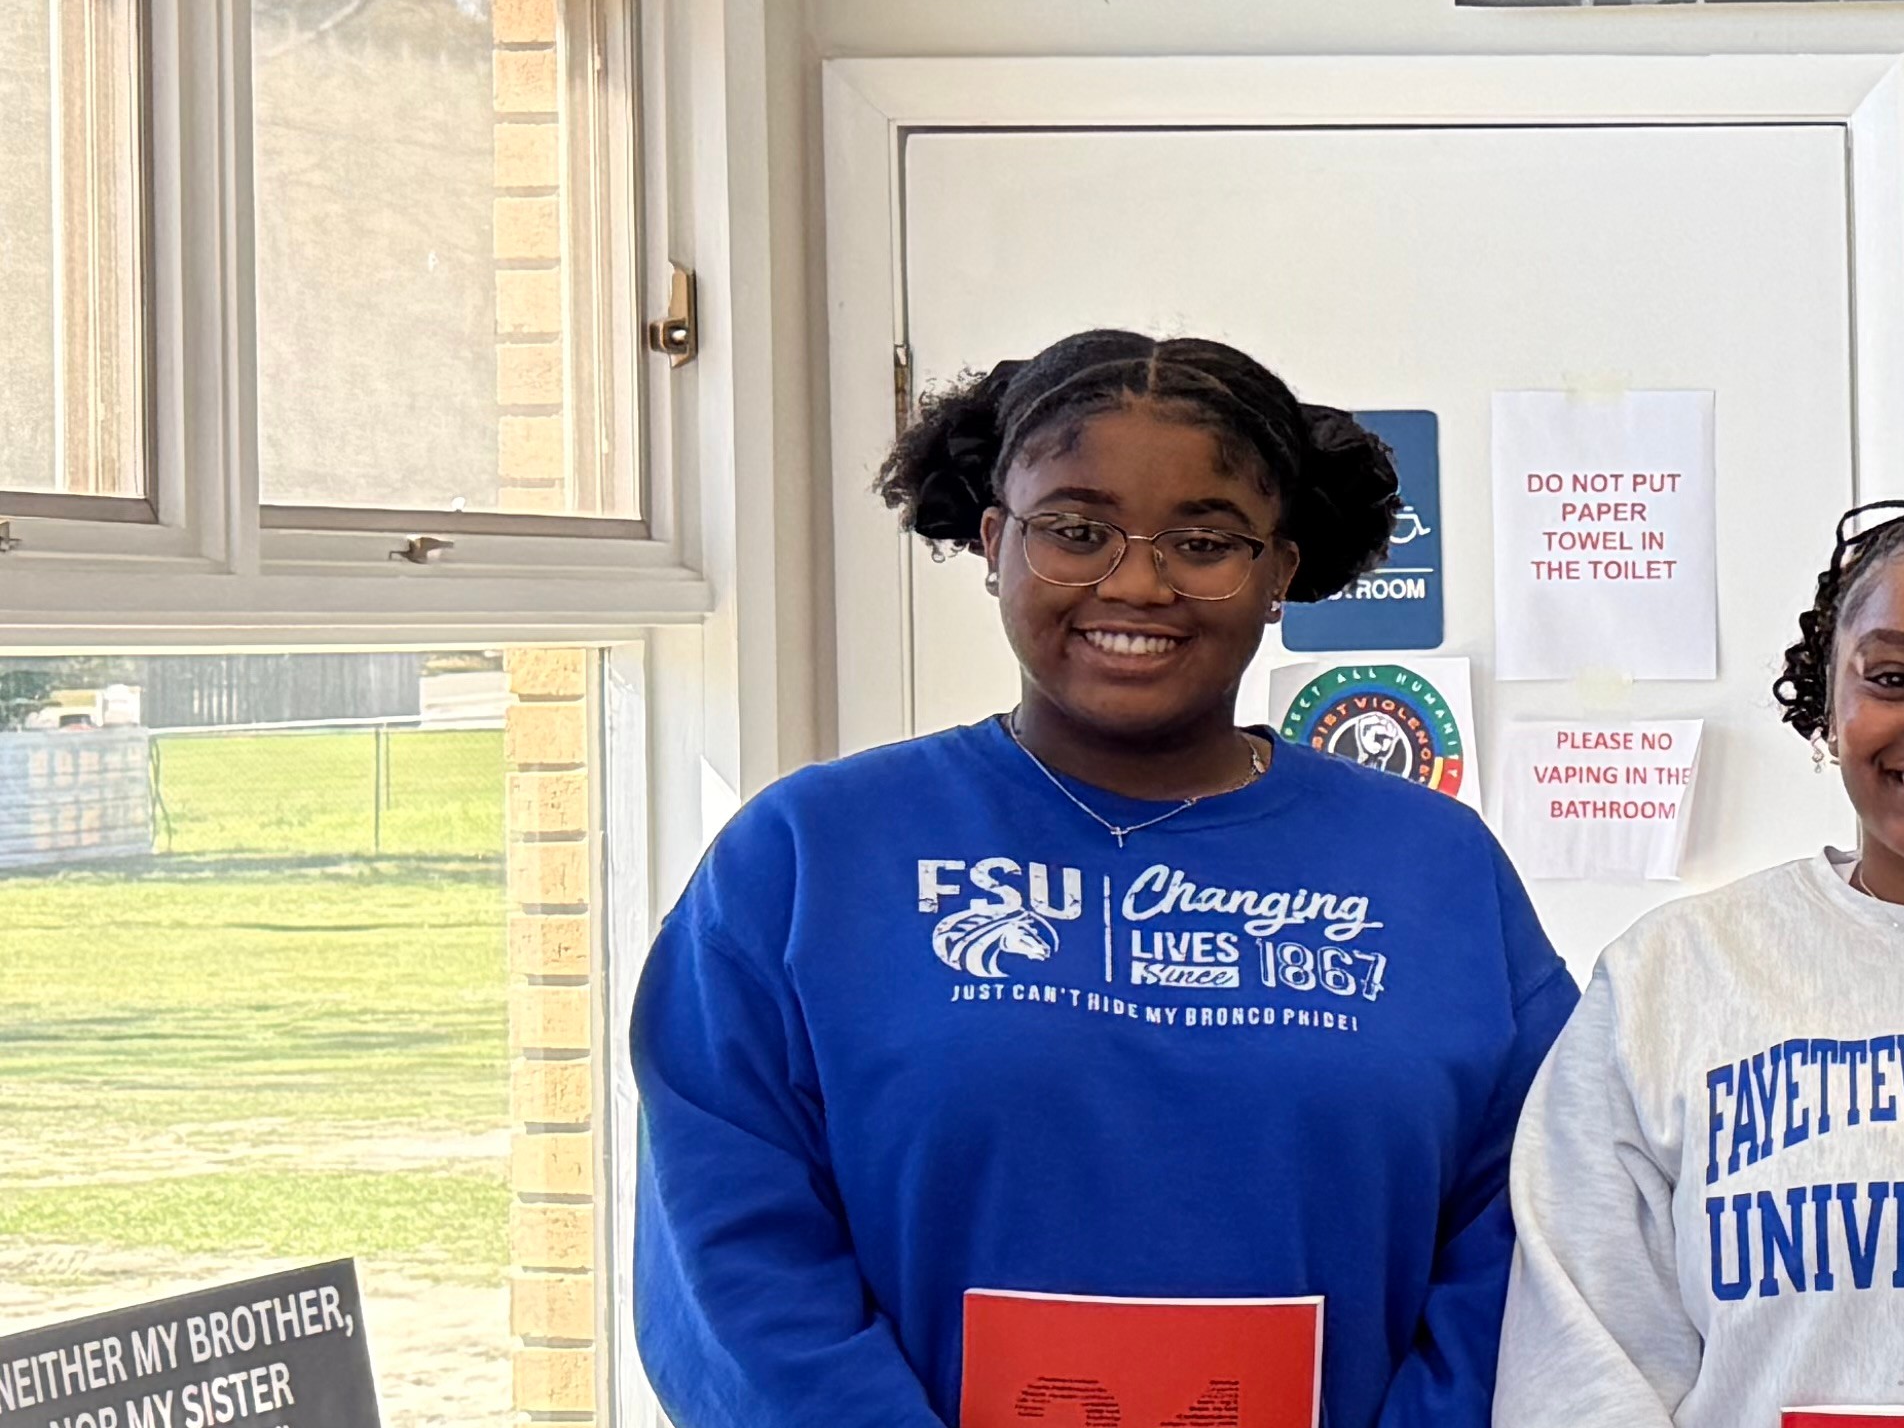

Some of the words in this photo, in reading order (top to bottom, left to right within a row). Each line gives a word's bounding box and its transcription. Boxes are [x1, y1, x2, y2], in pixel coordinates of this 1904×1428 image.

[1528, 474, 1562, 492] DO
[1573, 474, 1624, 492] NOT
[1633, 474, 1681, 492] PUT
[1562, 503, 1646, 521] PAPER
[1543, 532, 1633, 551] TOWEL
[1642, 532, 1663, 550] IN
[1531, 561, 1580, 580] THE
[1588, 561, 1677, 579] TOILET
[1557, 731, 1633, 749] PLEASE
[1642, 733, 1672, 750] NO
[1534, 766, 1617, 784] VAPING
[1626, 767, 1647, 784] IN
[1655, 767, 1690, 785] THE
[1550, 801, 1676, 820] BATHROOM
[918, 858, 1082, 920] FSU
[1121, 864, 1385, 941] Changing
[1132, 929, 1239, 963] LIVES
[1255, 936, 1387, 1001] 1867
[951, 983, 1003, 1002] JUST
[1012, 984, 1081, 1008] CAN'T
[1087, 992, 1139, 1019] HIDE
[1145, 1005, 1179, 1026] MY
[1185, 1006, 1276, 1027] BRONCO
[1282, 1008, 1358, 1032] PRIDE!
[131, 1322, 178, 1375] MY
[186, 1285, 354, 1364] BROTHER,
